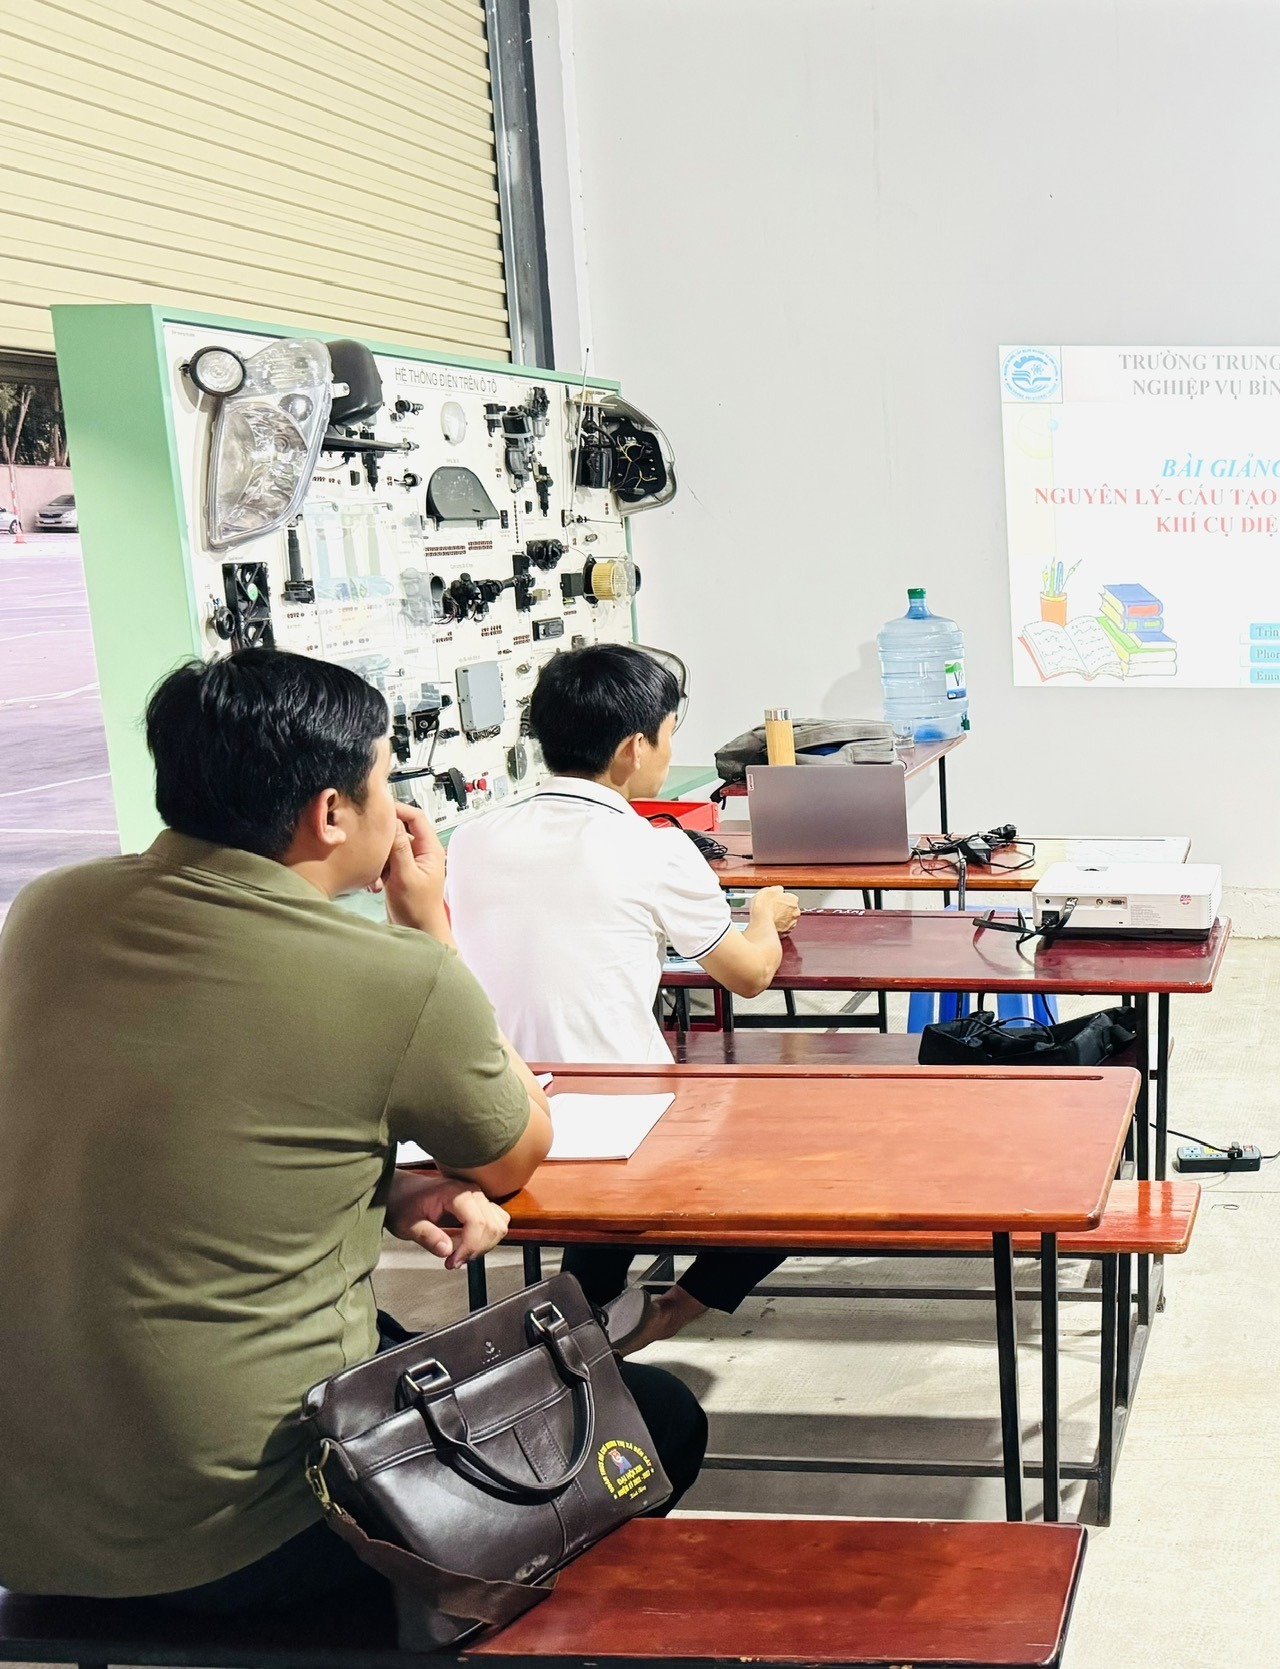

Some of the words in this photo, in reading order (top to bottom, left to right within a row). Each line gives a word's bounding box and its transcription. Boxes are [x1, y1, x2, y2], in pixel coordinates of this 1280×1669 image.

[1119, 350, 1207, 370] TRƯỜNG
[1133, 377, 1210, 400] NGHIỆP
[1215, 379, 1242, 400] VỤ
[1160, 452, 1204, 478] BÀI
[1034, 483, 1128, 506] NGUYÊN
[1229, 487, 1277, 510] TẠO
[1156, 511, 1197, 533] KHÍ
[1203, 514, 1234, 538] CỤ
